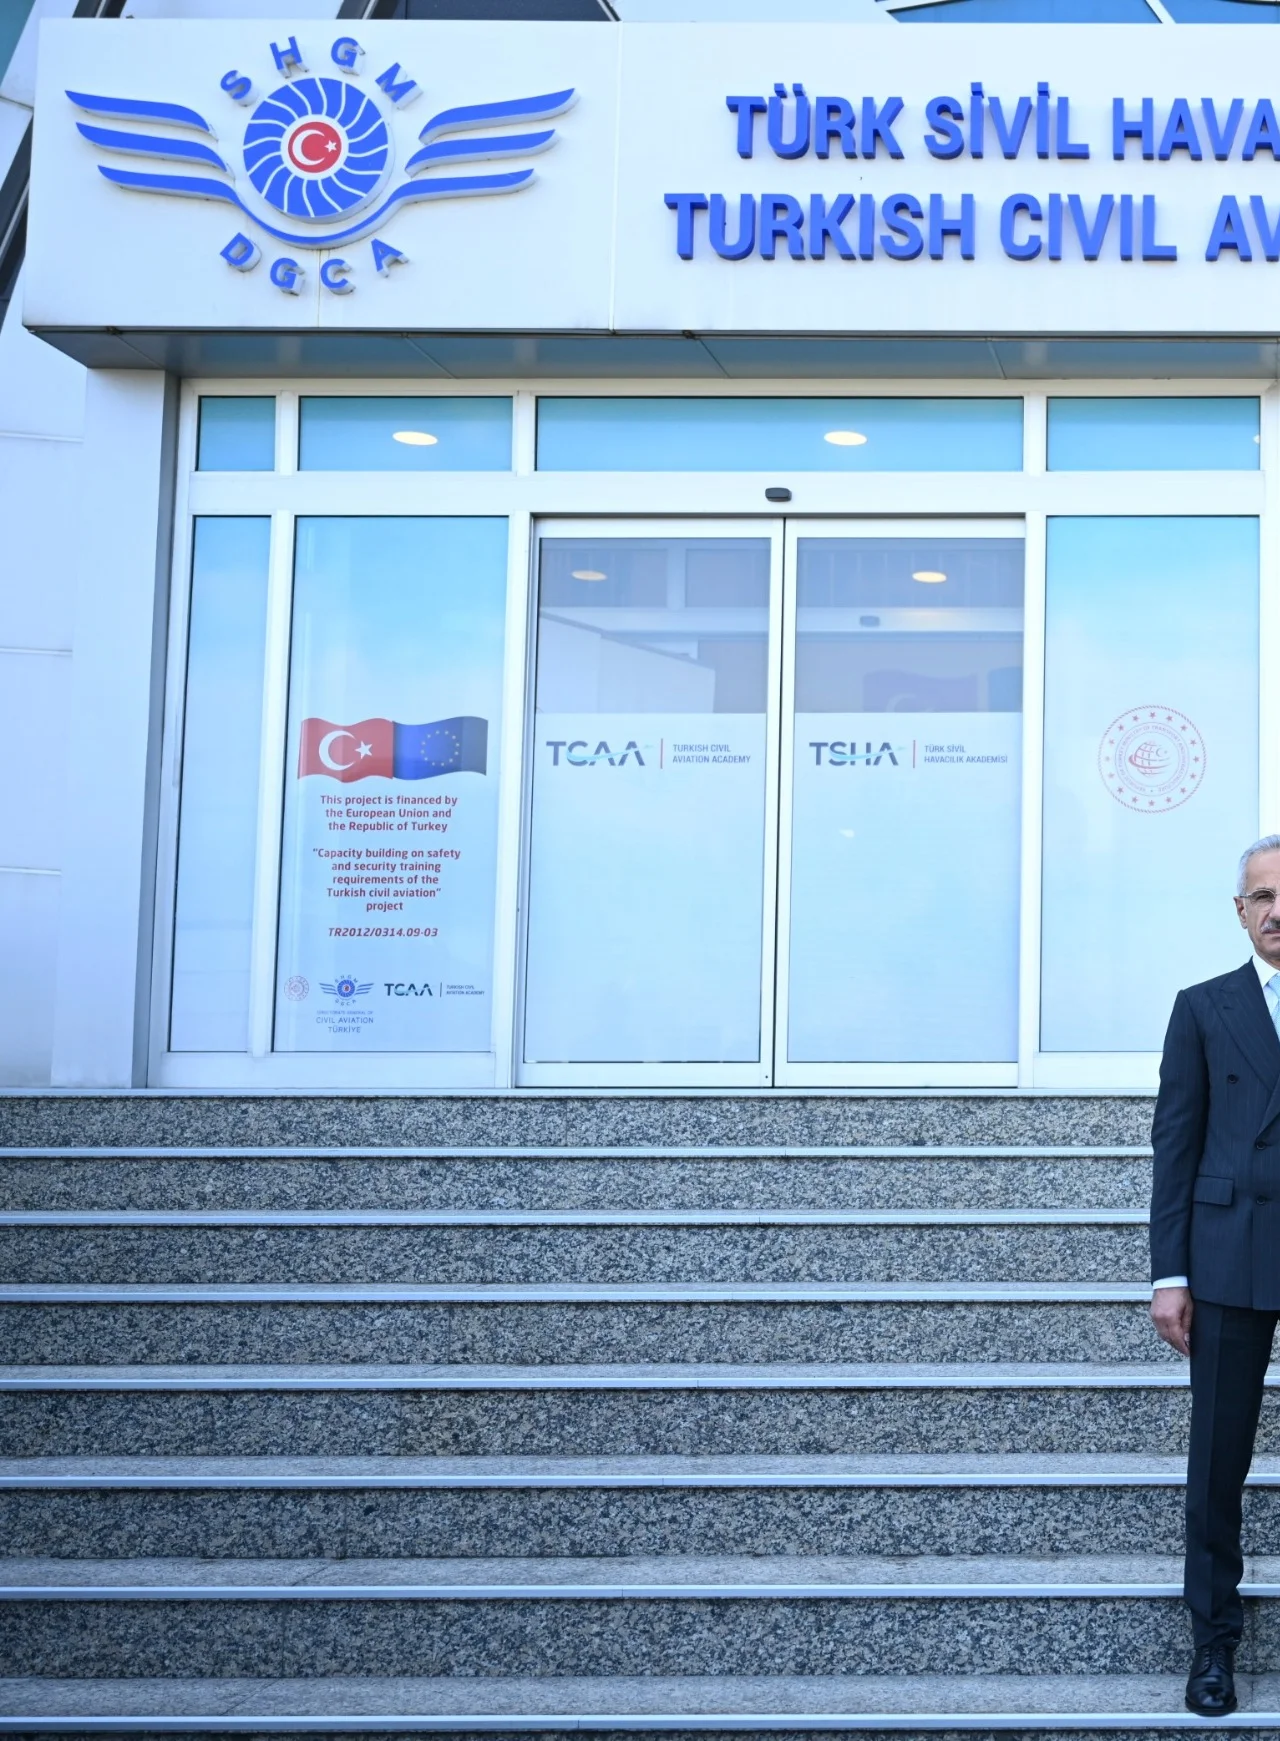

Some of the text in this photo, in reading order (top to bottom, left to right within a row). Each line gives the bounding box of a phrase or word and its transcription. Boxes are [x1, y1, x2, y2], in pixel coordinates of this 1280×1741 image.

[220, 36, 422, 109] SHGM
[726, 82, 904, 160] TÜRK
[924, 82, 1089, 160] SİVİL
[664, 193, 975, 261] TURKISH
[1000, 193, 1177, 261] CIVIL
[220, 232, 409, 296] DGCA
[545, 740, 646, 767] TCAA
[672, 744, 732, 753] TURKISH CIVIL
[808, 741, 899, 767] TSHA
[924, 744, 966, 754] TÜRK SİVİL
[672, 754, 752, 764] AVIATION ACADEMY
[924, 754, 1008, 764] HAVACILIK AKADEMİSİ
[320, 795, 458, 806] This project is financed by
[325, 808, 452, 820] the European Union and
[328, 821, 448, 832] the Republic of Turkey
[365, 848, 408, 860] building
[411, 850, 424, 858] on
[427, 848, 461, 860] safety
[332, 862, 442, 873] and security training
[332, 875, 439, 886] requirements of the
[327, 888, 366, 898] Turkish
[368, 888, 390, 898] civil
[366, 902, 404, 912] project
[328, 927, 438, 938] TR2012/0314.09-03
[384, 983, 433, 996] TCAA
[316, 1016, 374, 1024] CIVIL AVIATION
[328, 1025, 361, 1033] TÜRKİYE
